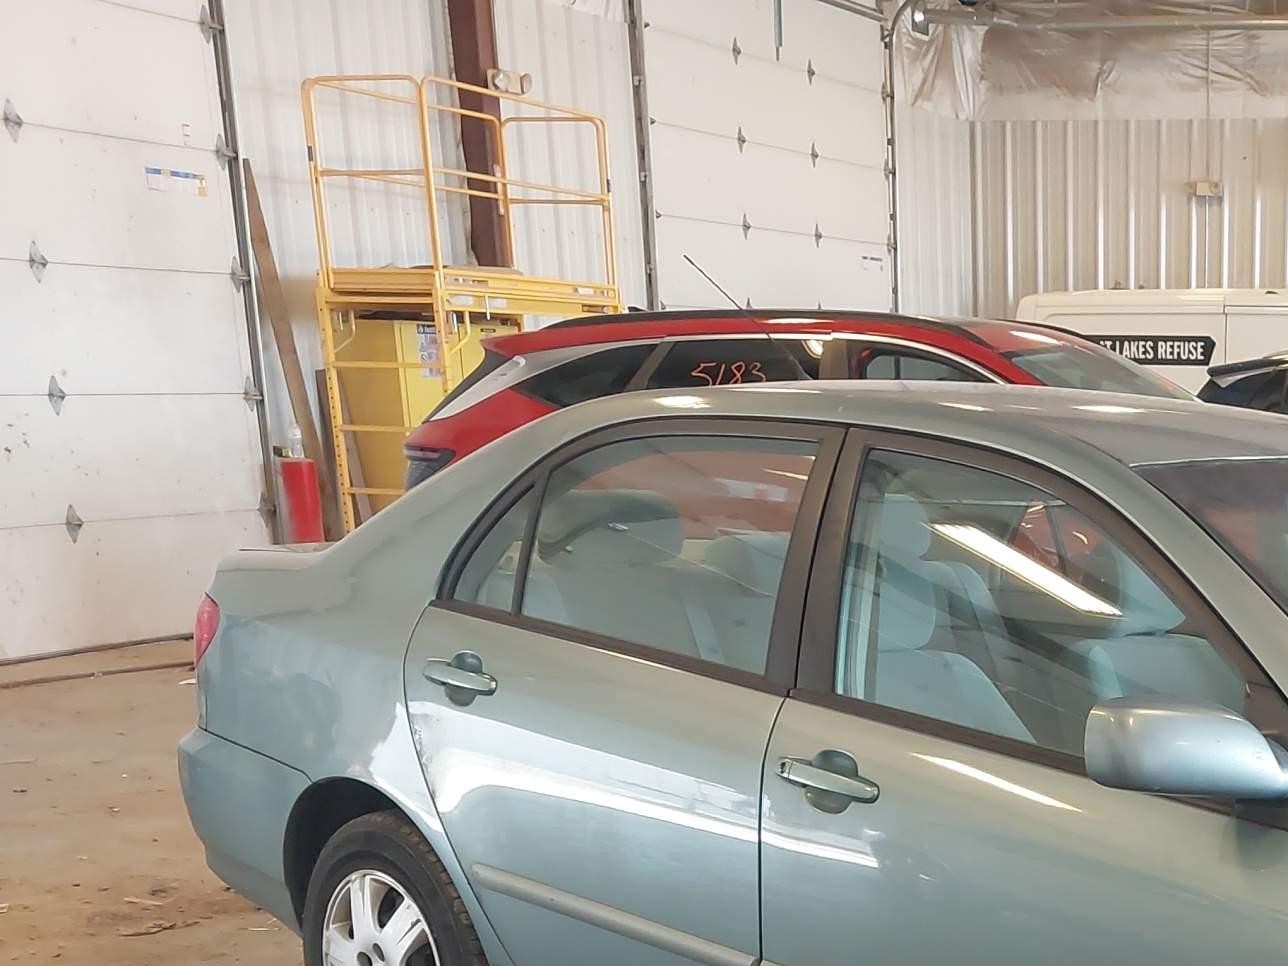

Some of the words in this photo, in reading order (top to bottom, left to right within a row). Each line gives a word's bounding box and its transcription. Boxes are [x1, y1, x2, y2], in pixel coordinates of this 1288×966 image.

[1115, 340, 1154, 359] LAKES
[1157, 341, 1205, 360] REFUSE
[691, 361, 767, 387] 5183
